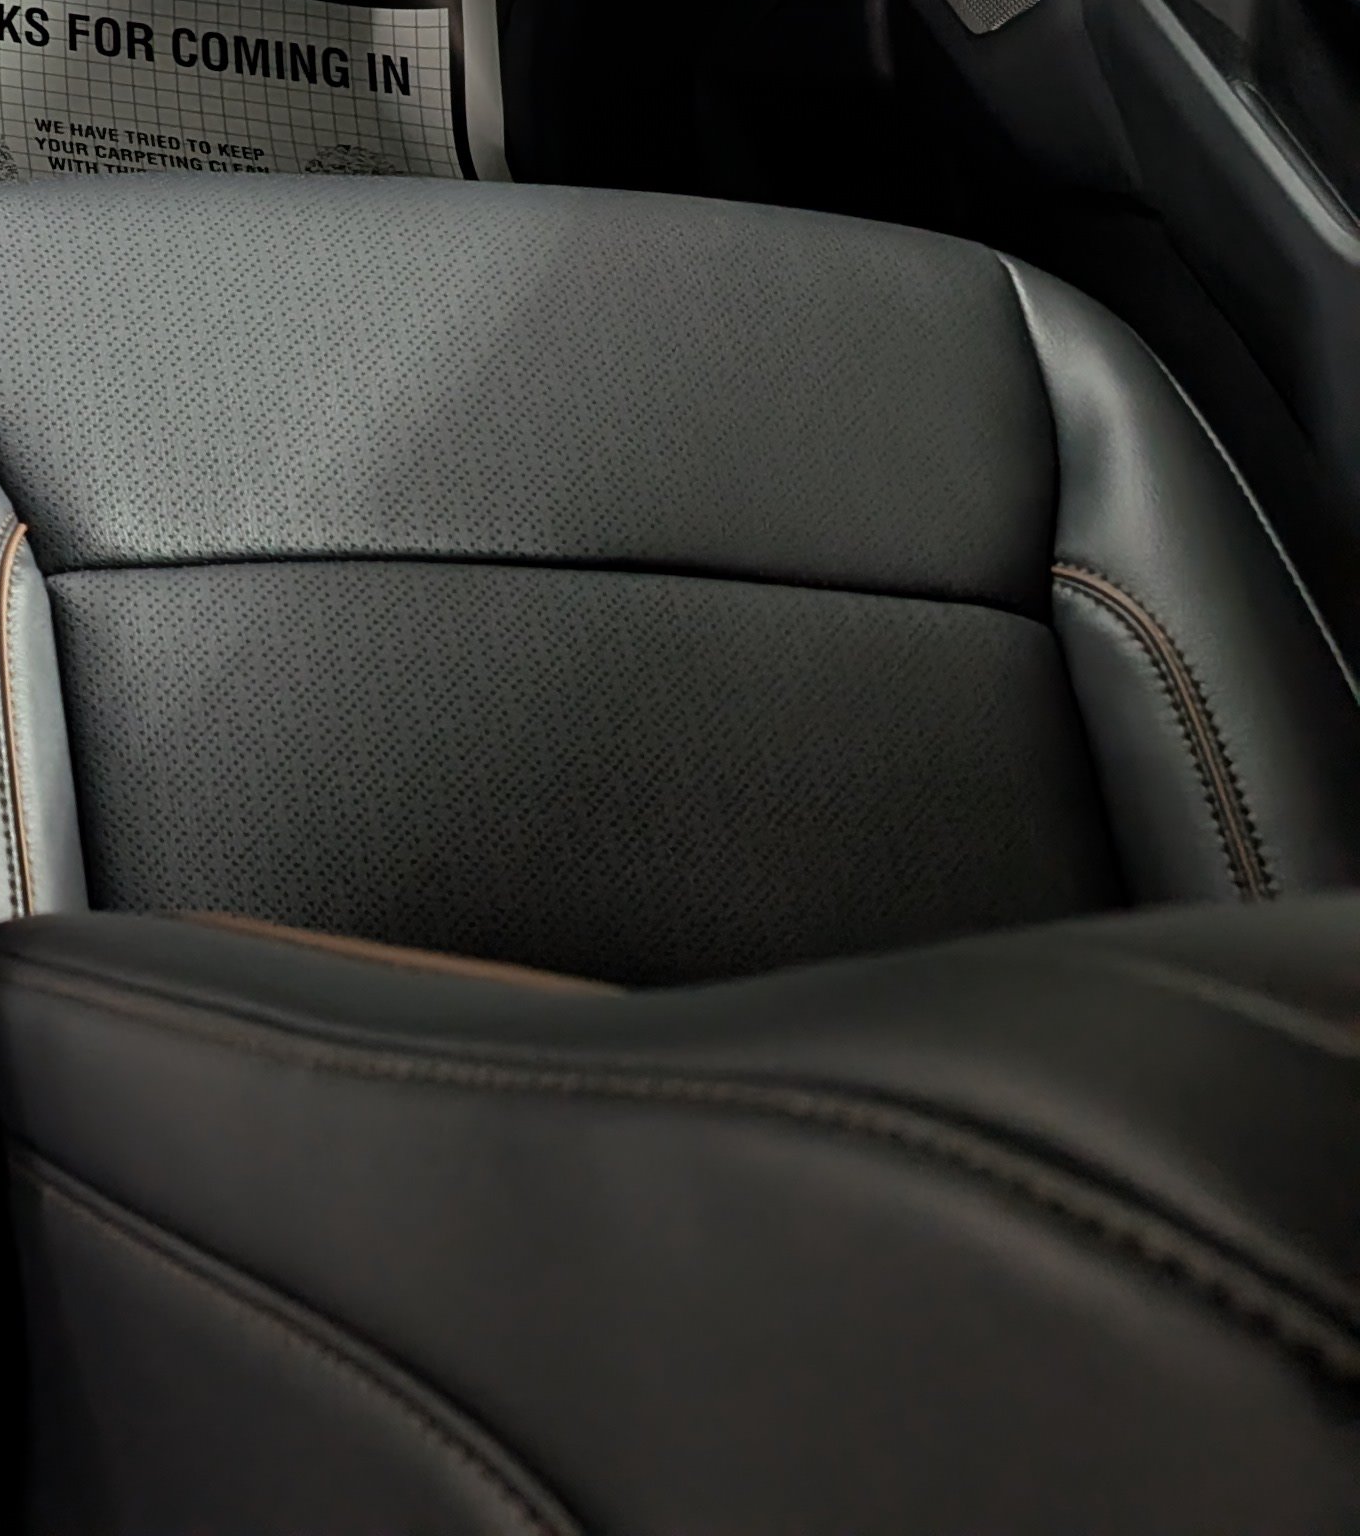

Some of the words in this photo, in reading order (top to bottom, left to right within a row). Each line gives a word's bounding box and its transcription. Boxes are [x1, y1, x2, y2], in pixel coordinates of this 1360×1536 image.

[67, 11, 156, 63] FOR
[171, 26, 352, 89] COMING
[366, 51, 412, 97] IN
[34, 117, 64, 135] WE
[69, 123, 120, 143] HAVE
[124, 129, 181, 150] TRIED
[185, 138, 212, 156] TO
[217, 143, 265, 162] KEEP
[34, 136, 89, 156] YOUR
[94, 144, 203, 171] CARPETING
[47, 155, 99, 174] WITH
